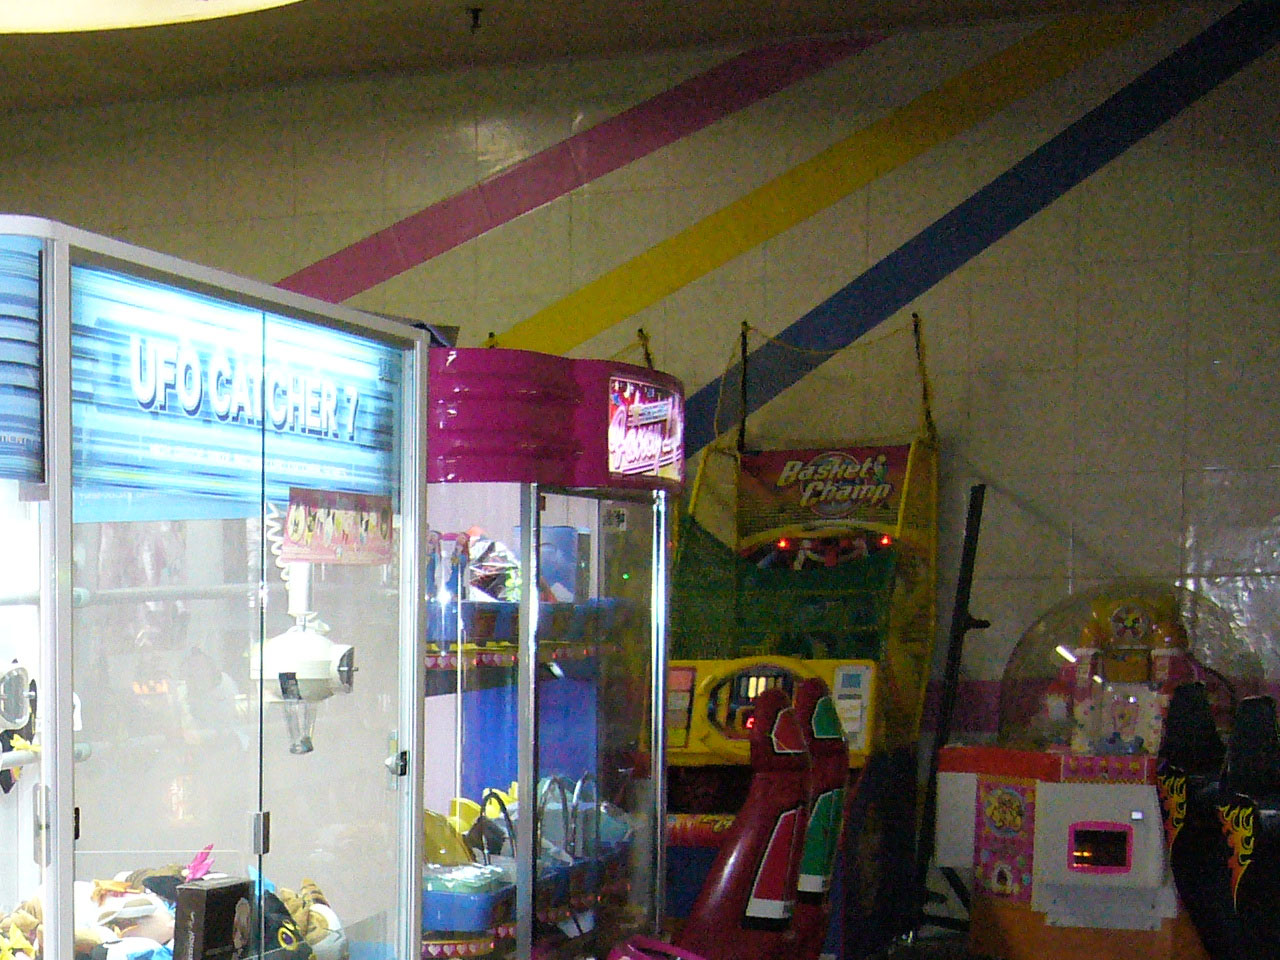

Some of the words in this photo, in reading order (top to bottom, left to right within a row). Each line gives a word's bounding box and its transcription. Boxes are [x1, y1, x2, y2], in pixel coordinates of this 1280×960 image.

[130, 334, 203, 416] UFO
[209, 348, 339, 439] CATCHER
[345, 384, 359, 441] 7
